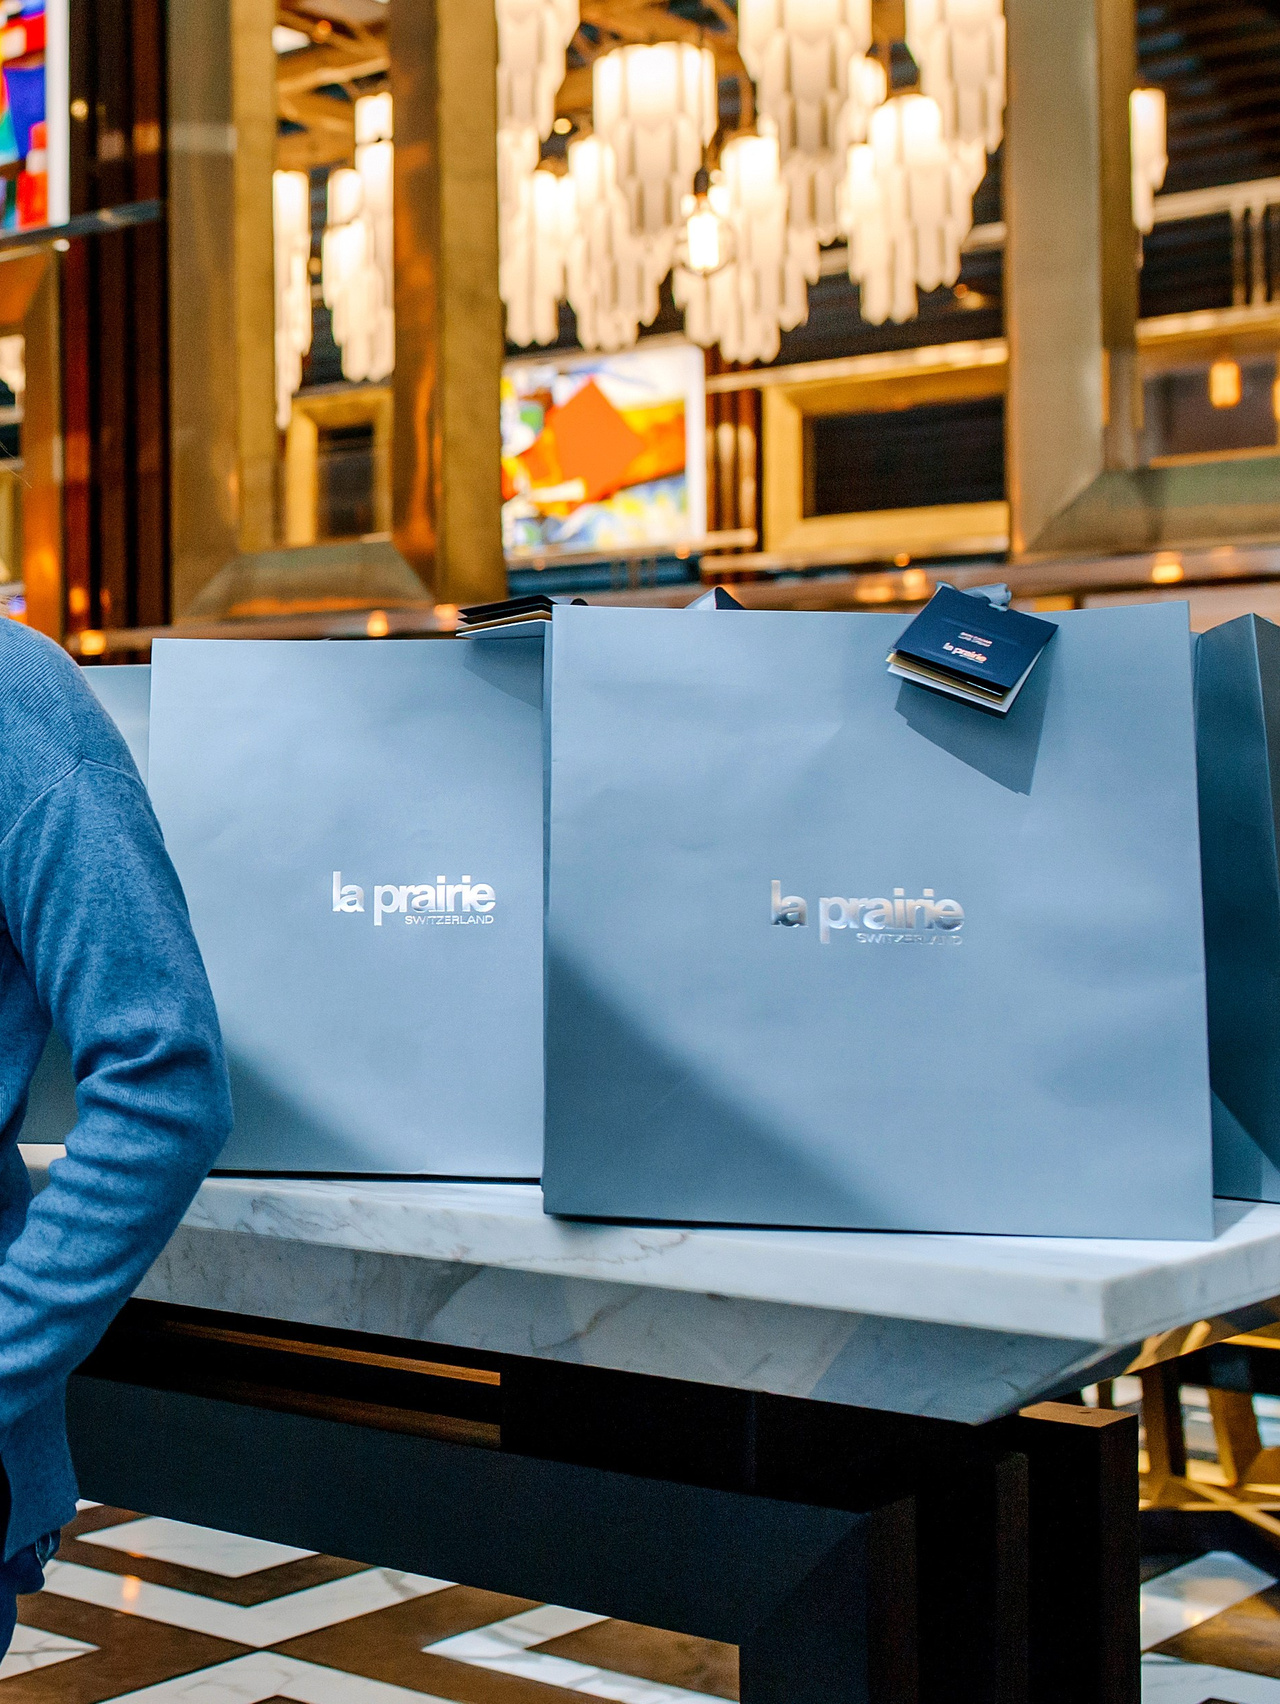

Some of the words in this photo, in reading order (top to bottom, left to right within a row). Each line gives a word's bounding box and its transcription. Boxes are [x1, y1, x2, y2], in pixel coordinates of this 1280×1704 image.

[332, 871, 365, 913] la
[373, 875, 496, 926] prairie
[771, 880, 808, 928] la
[819, 888, 965, 944] prairie
[404, 915, 494, 925] SWITZERLAND
[856, 932, 963, 945] SWITZERLAND
